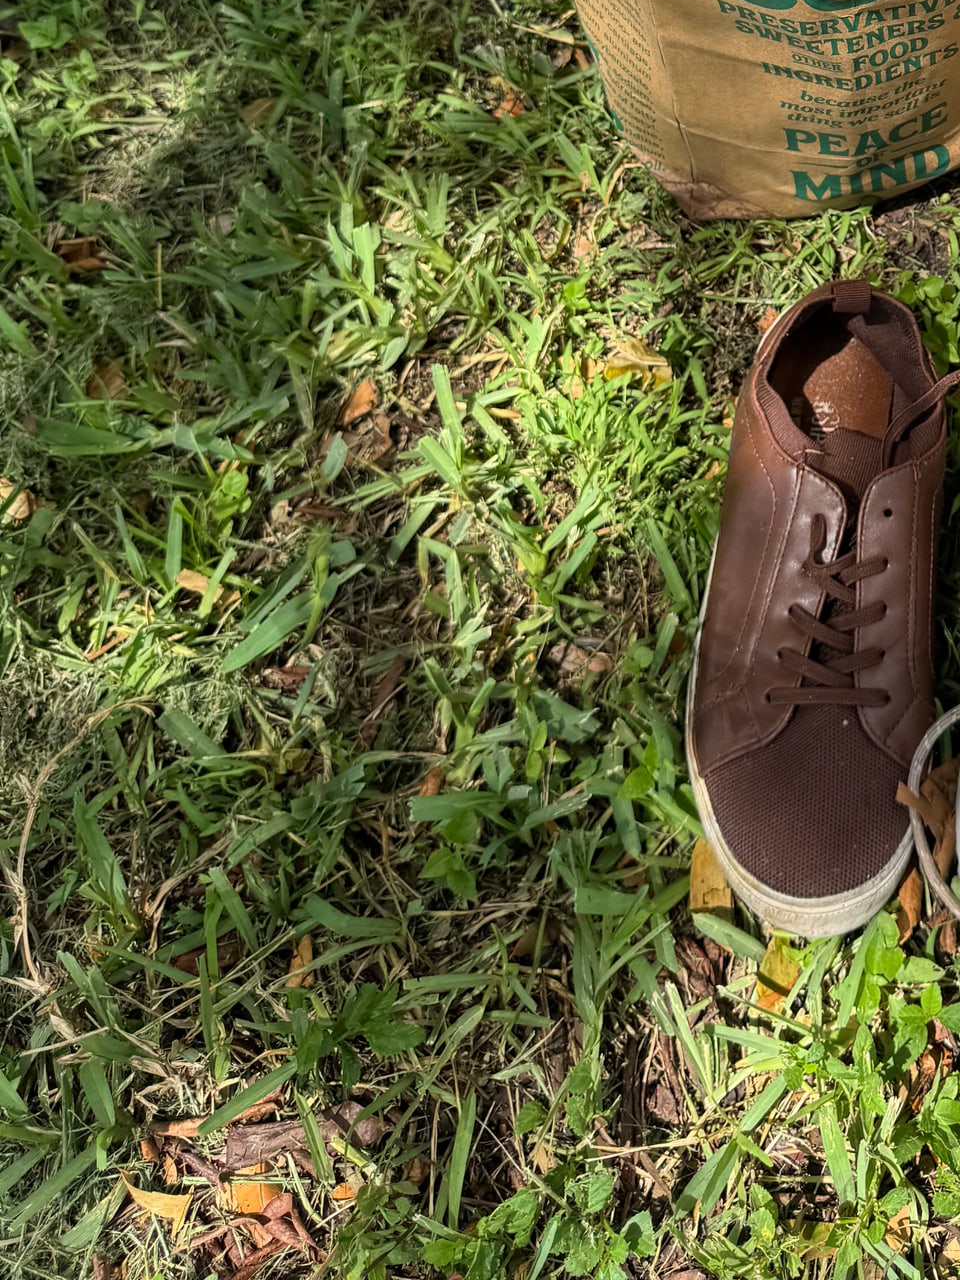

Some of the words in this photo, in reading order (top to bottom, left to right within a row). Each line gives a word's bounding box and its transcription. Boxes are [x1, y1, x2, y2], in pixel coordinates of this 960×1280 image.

[632, 36, 652, 58] and
[735, 13, 945, 57] SWEETENERS
[792, 52, 842, 72] OTHER
[852, 36, 929, 73] FOOD
[761, 41, 960, 93] INGREDIENTS
[779, 100, 837, 117] most
[839, 78, 947, 118] important
[787, 113, 843, 129] thing
[849, 114, 879, 127] we
[884, 98, 919, 119] sell
[924, 90, 942, 103] is
[800, 90, 889, 108] because
[894, 76, 927, 95] the
[783, 101, 949, 157] PEACE
[791, 144, 951, 201] MIND
[856, 150, 884, 168] OF
